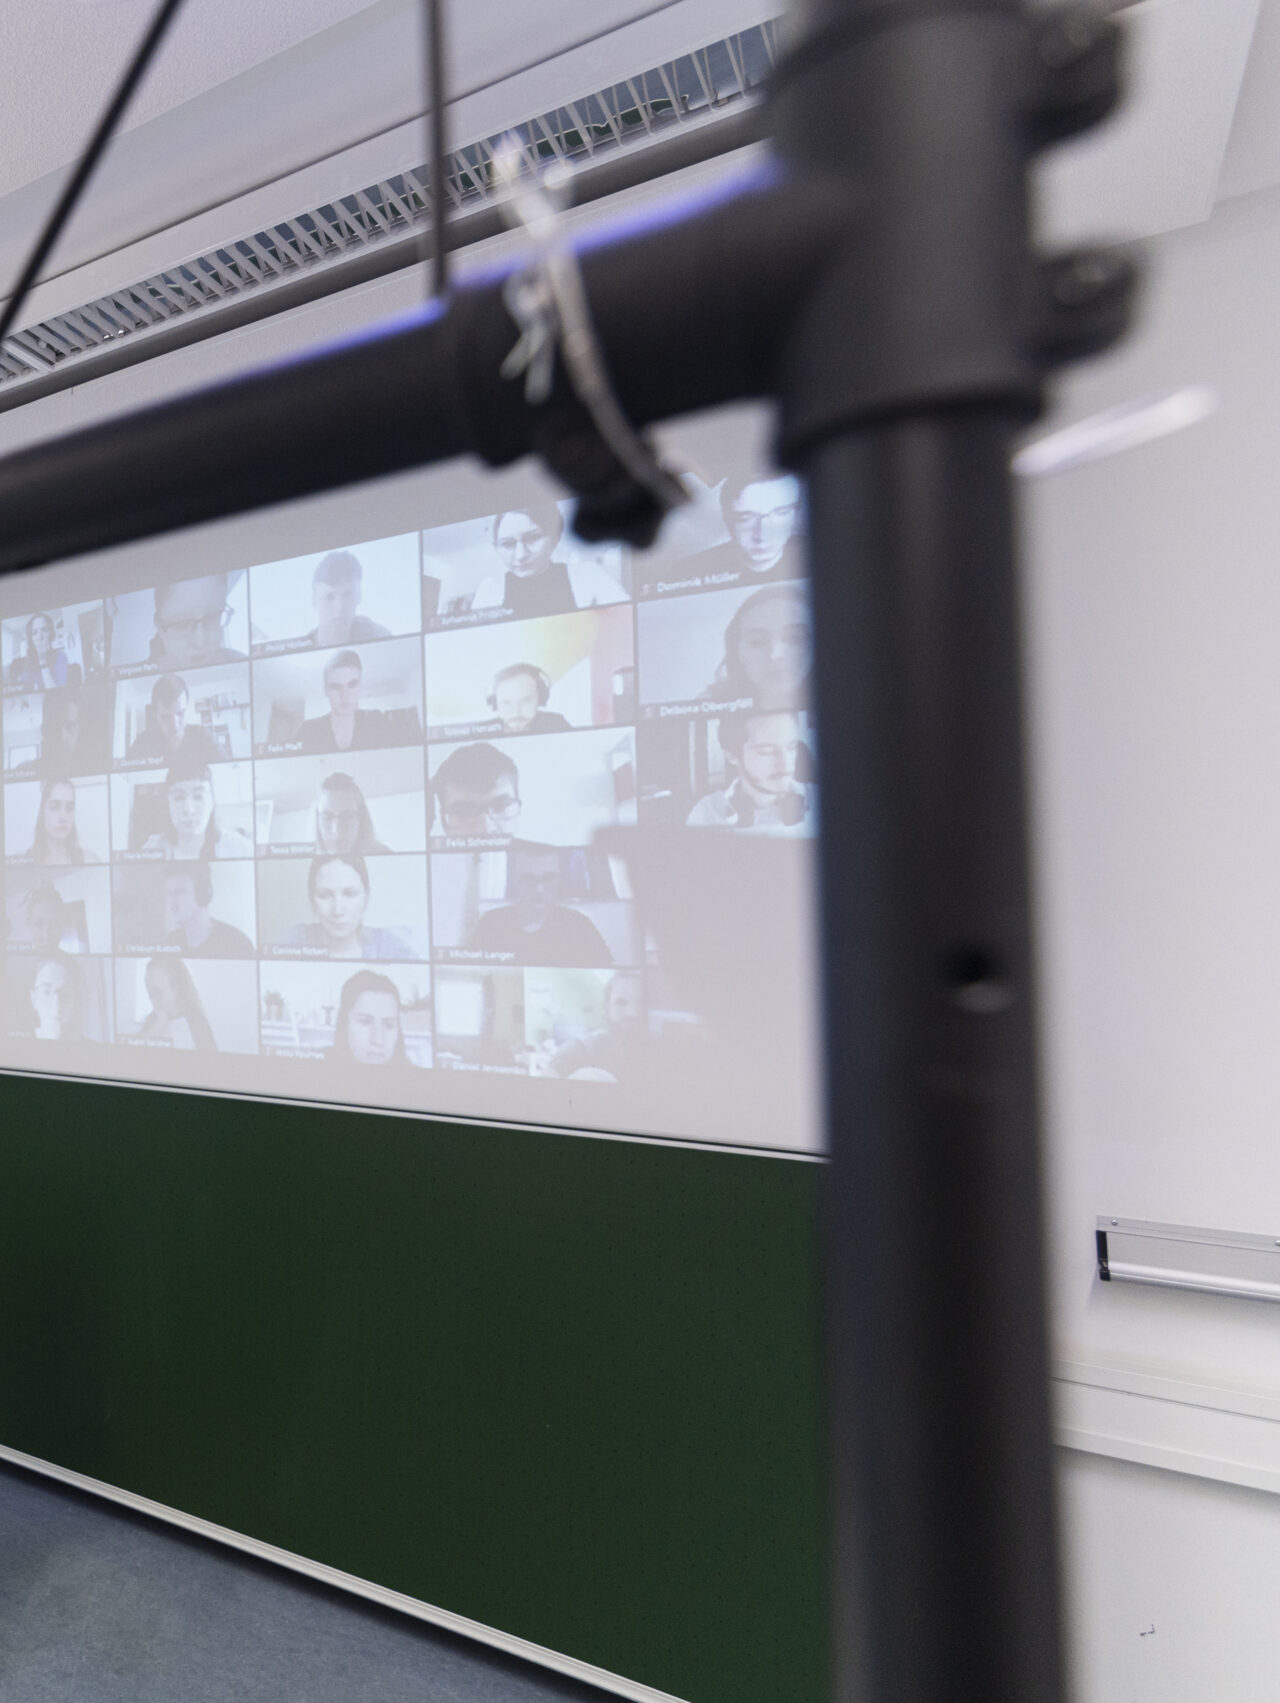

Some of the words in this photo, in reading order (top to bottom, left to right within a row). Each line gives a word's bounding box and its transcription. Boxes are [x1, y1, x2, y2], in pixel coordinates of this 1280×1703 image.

[657, 576, 701, 592] Dominik
[704, 571, 741, 584] Müller
[449, 949, 483, 959] Michael
[484, 950, 516, 962] Langer
